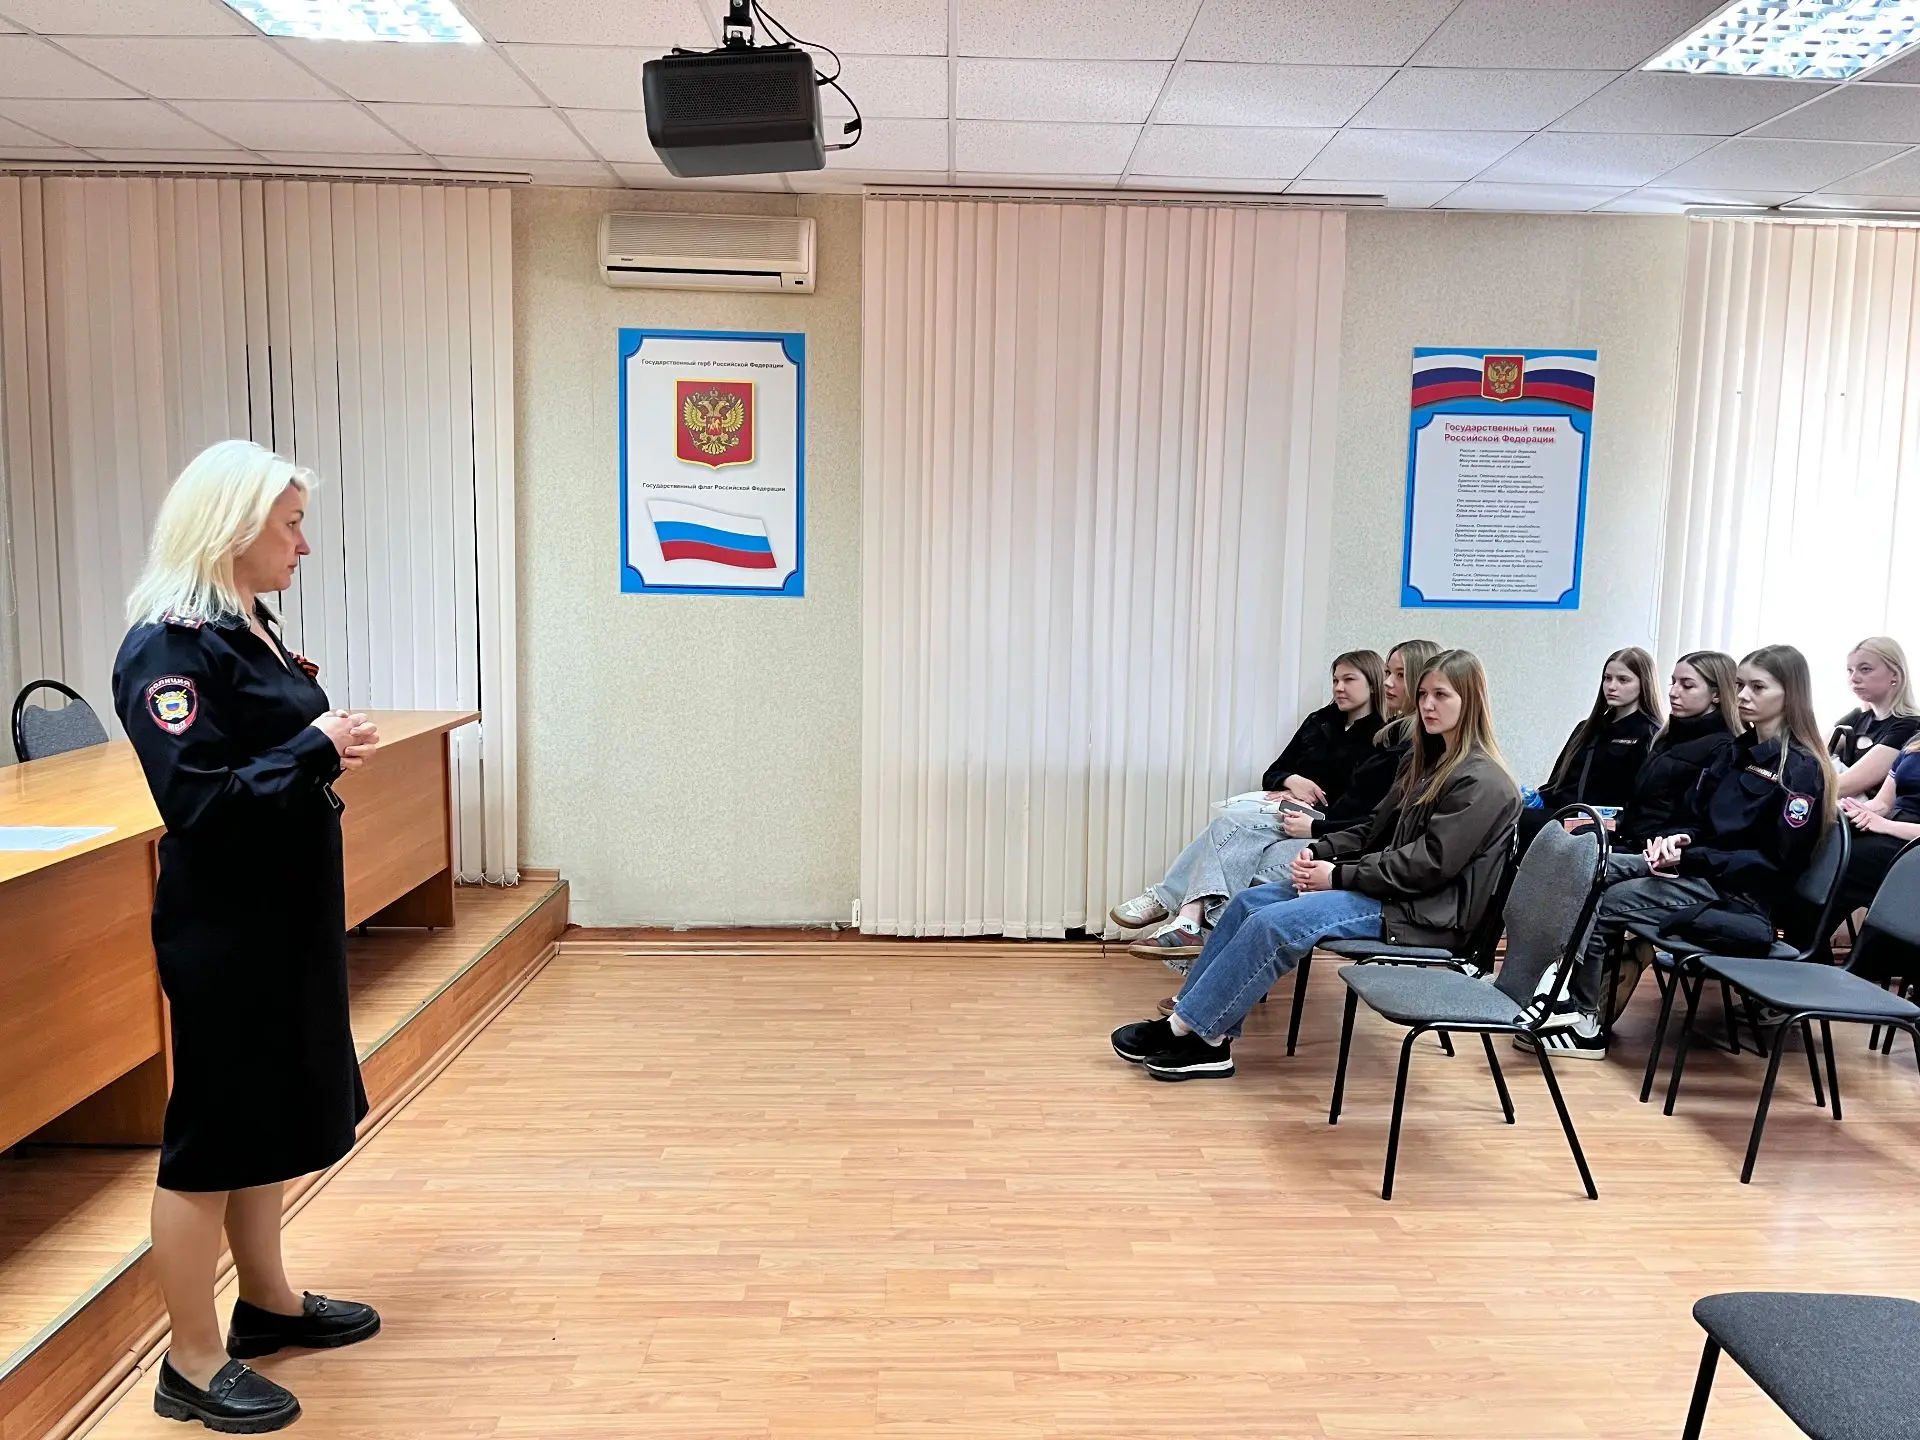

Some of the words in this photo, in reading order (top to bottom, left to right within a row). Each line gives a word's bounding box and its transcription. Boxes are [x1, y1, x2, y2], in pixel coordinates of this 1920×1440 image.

[1445, 422, 1528, 433] Государственный
[1502, 434, 1554, 444] Федерации
[148, 678, 191, 694] ПОЛИЦИЯ
